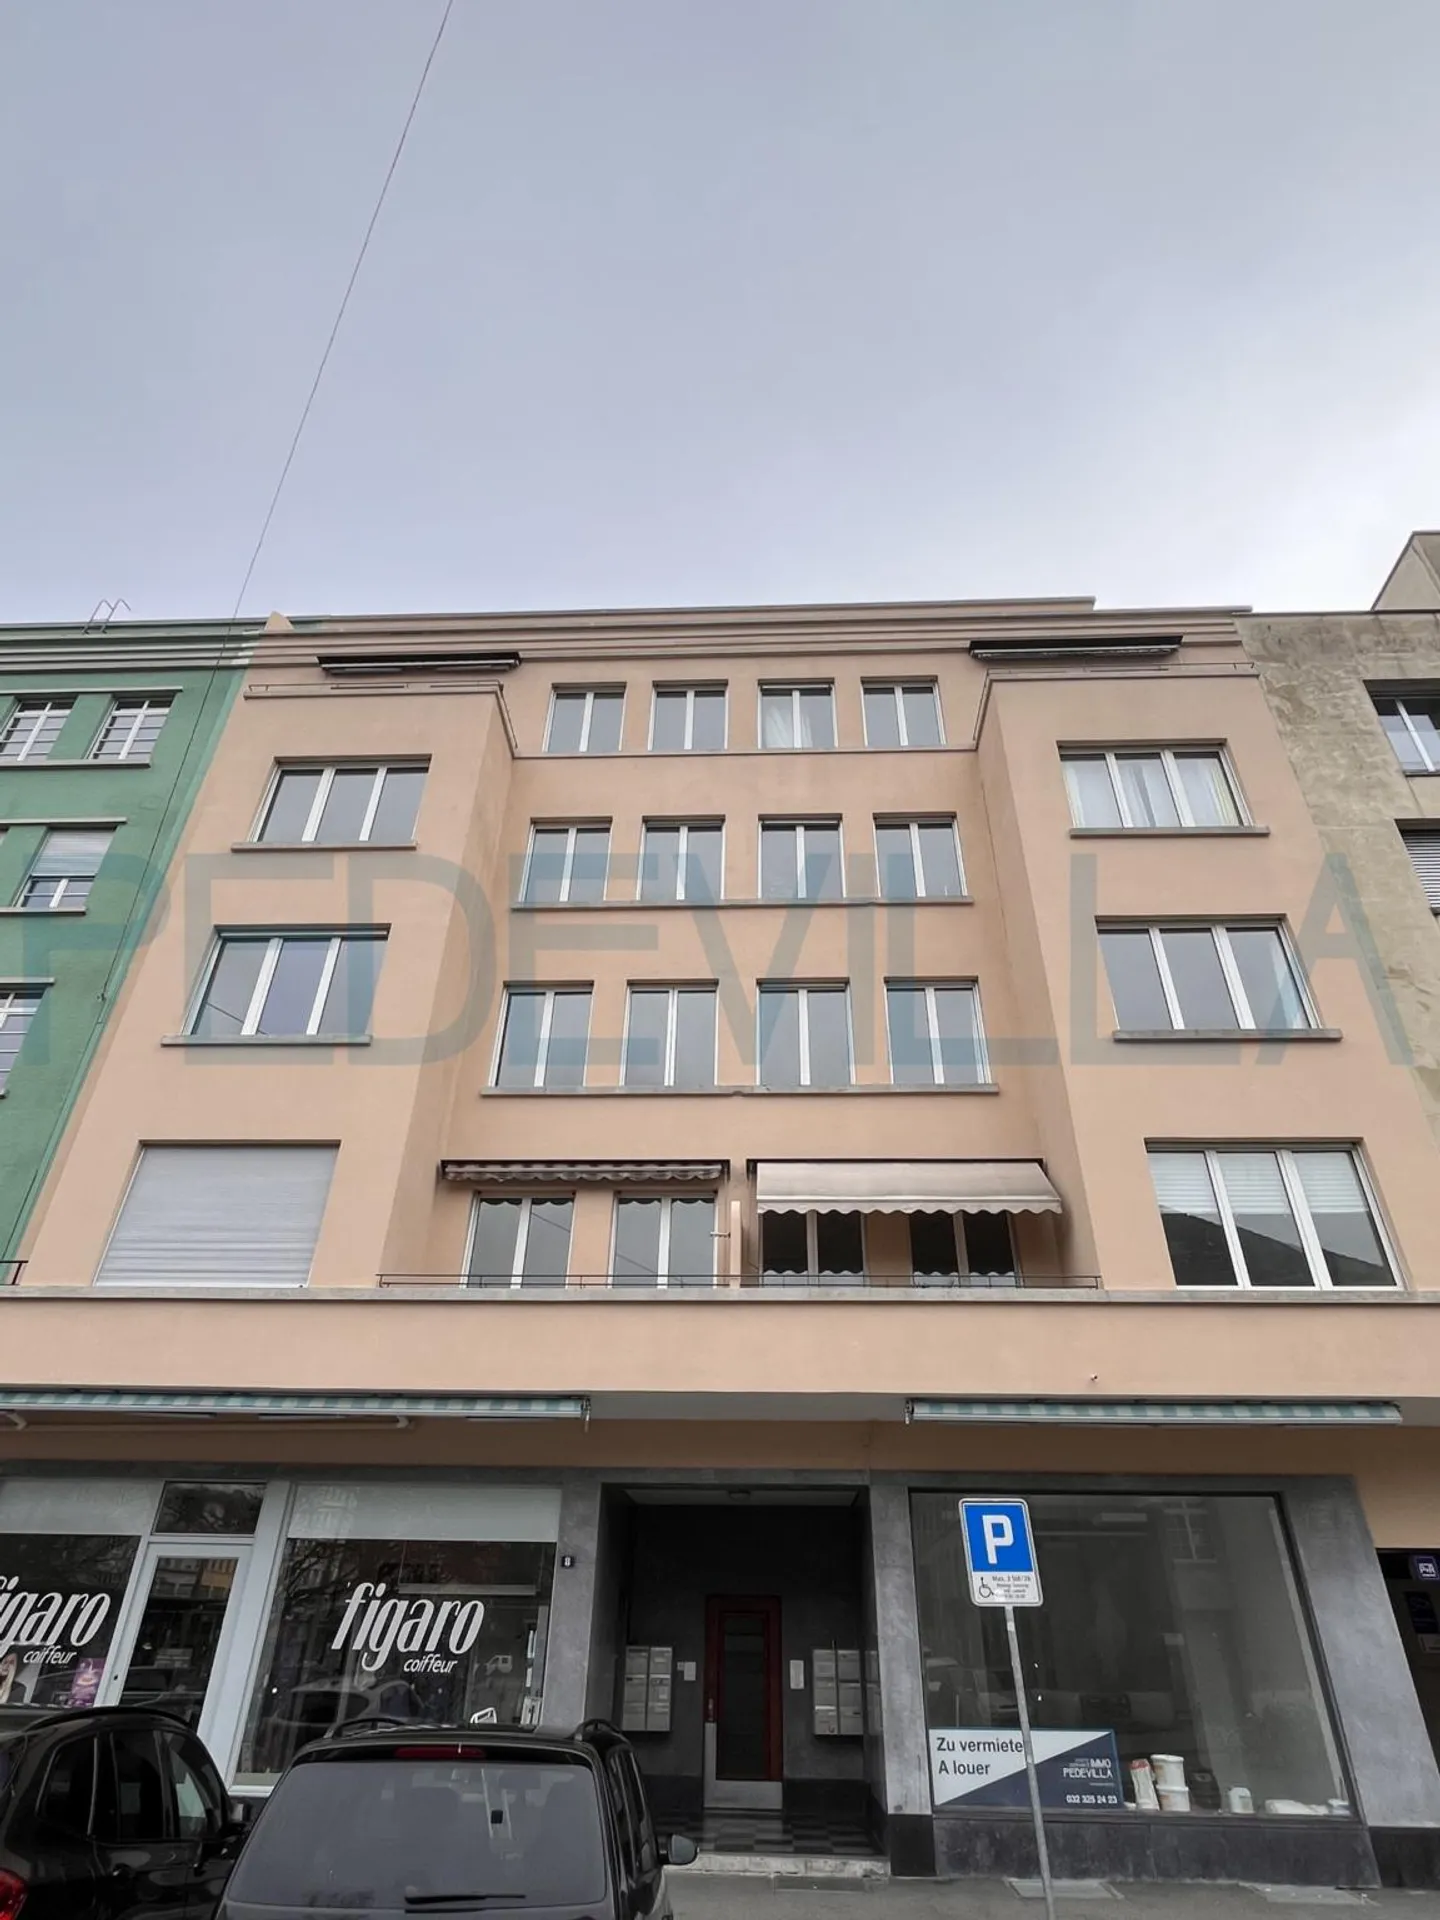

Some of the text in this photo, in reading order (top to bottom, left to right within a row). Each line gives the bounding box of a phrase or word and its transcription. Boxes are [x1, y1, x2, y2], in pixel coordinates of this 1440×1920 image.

[983, 1515, 1014, 1564] P
[331, 1582, 485, 1672] figaro
[23, 1645, 77, 1664] coiffeur
[403, 1653, 458, 1673] coiffeur
[936, 1737, 1024, 1752] Zu vermiete
[938, 1760, 991, 1775] A louer
[1063, 1767, 1113, 1778] PEDEVILLA
